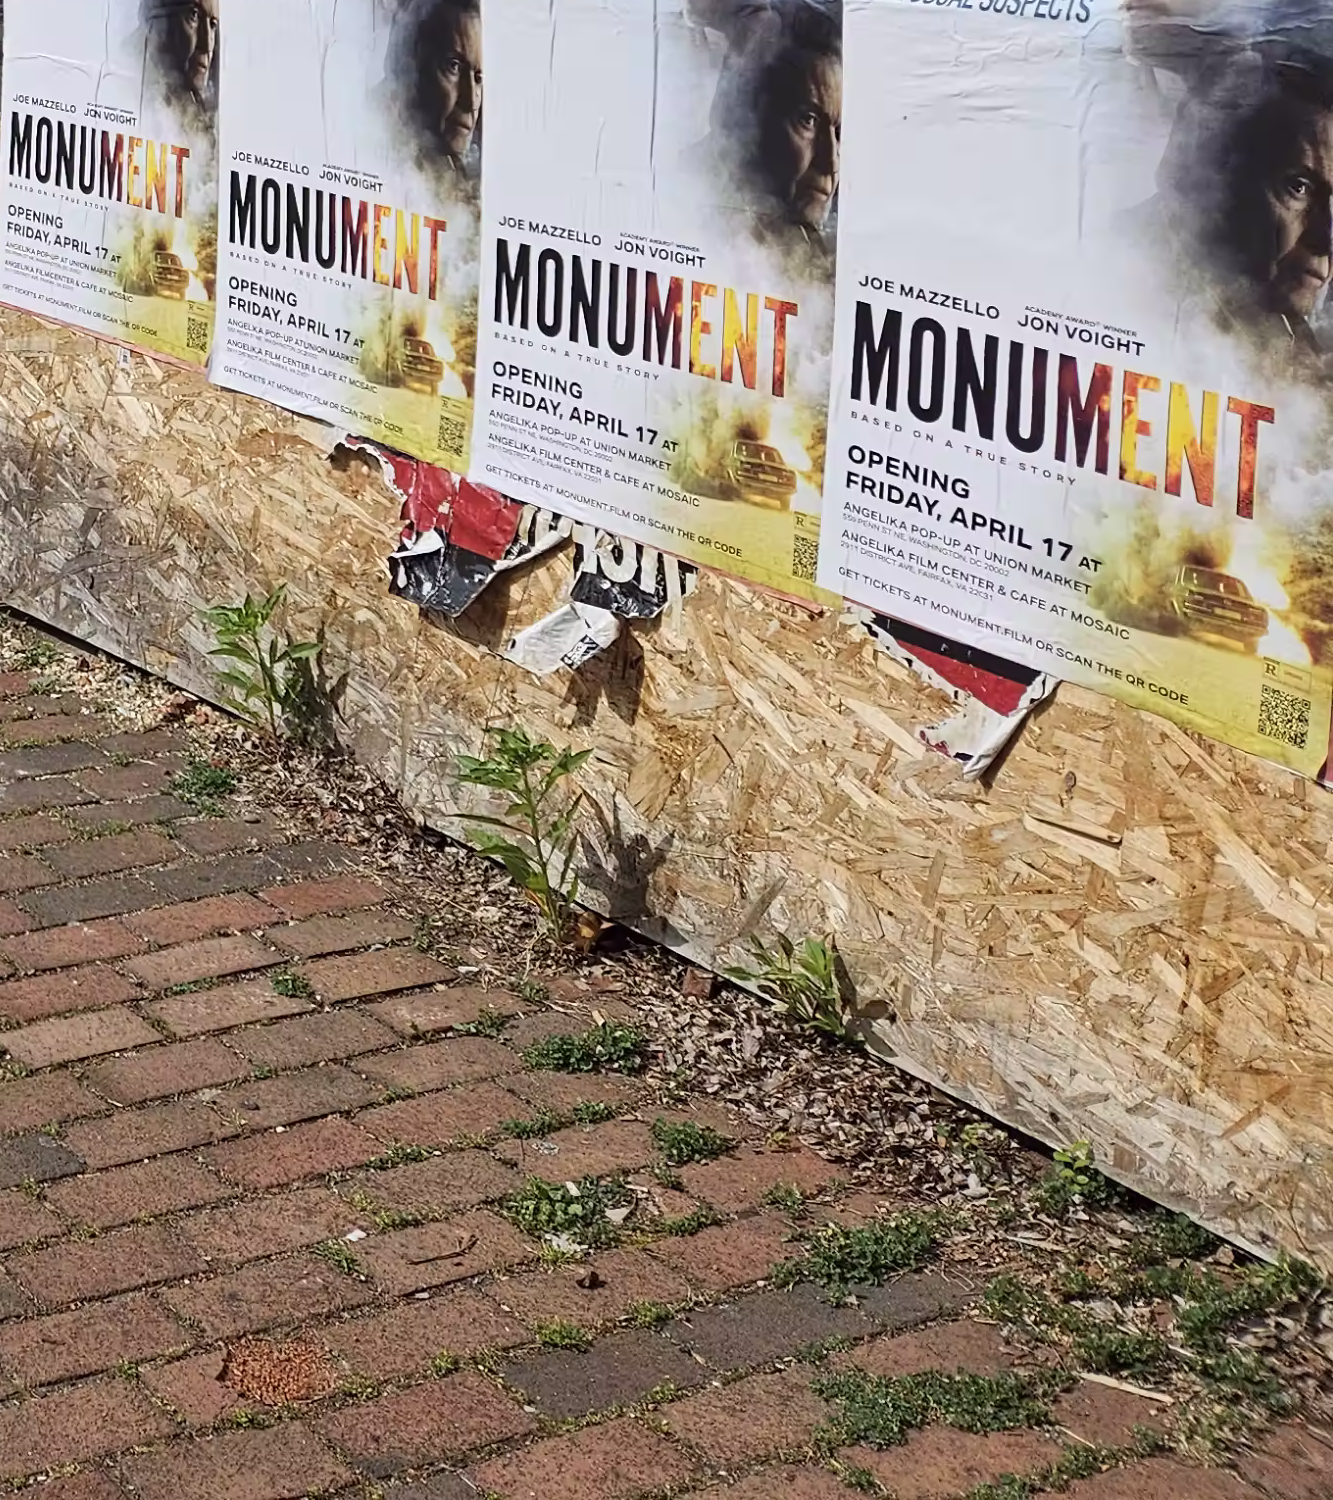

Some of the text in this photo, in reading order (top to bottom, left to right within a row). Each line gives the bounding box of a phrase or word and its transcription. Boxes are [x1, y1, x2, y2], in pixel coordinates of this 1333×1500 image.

[9, 112, 189, 218] MONUMENT
[8, 204, 64, 229] OPENING
[229, 170, 446, 301] MONUMENT
[229, 276, 298, 307] OPENING
[494, 238, 798, 398] MONUMENT
[492, 361, 583, 399] OPENING
[850, 301, 1275, 520] MONUMENT
[847, 444, 970, 499] OPENING
